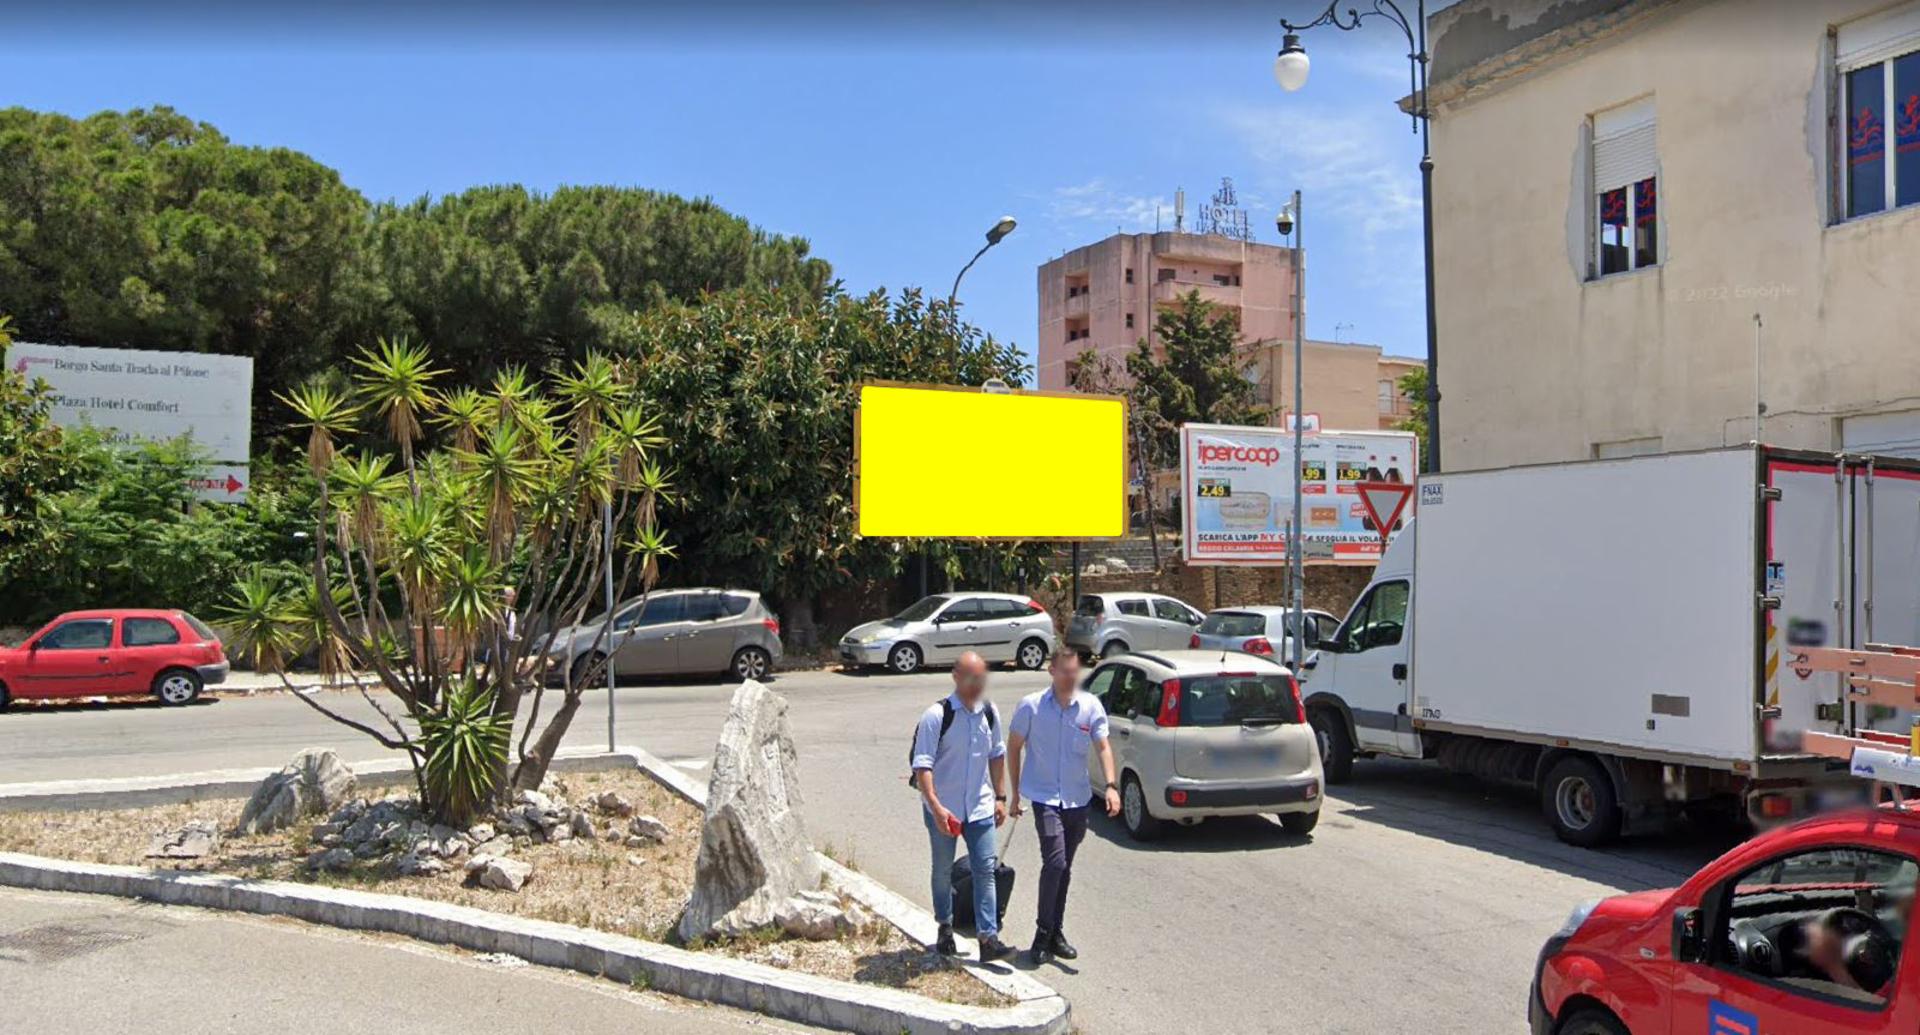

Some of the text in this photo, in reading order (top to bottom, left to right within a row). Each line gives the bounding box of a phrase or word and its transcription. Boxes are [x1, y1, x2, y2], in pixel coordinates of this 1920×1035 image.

[54, 358, 88, 373] Borgo
[90, 360, 122, 373] Santa
[125, 361, 159, 375] Trada
[53, 395, 179, 413] Plaza Hotel Comfort
[1197, 439, 1280, 466] ipercoop
[1197, 533, 1233, 542] SCARICA
